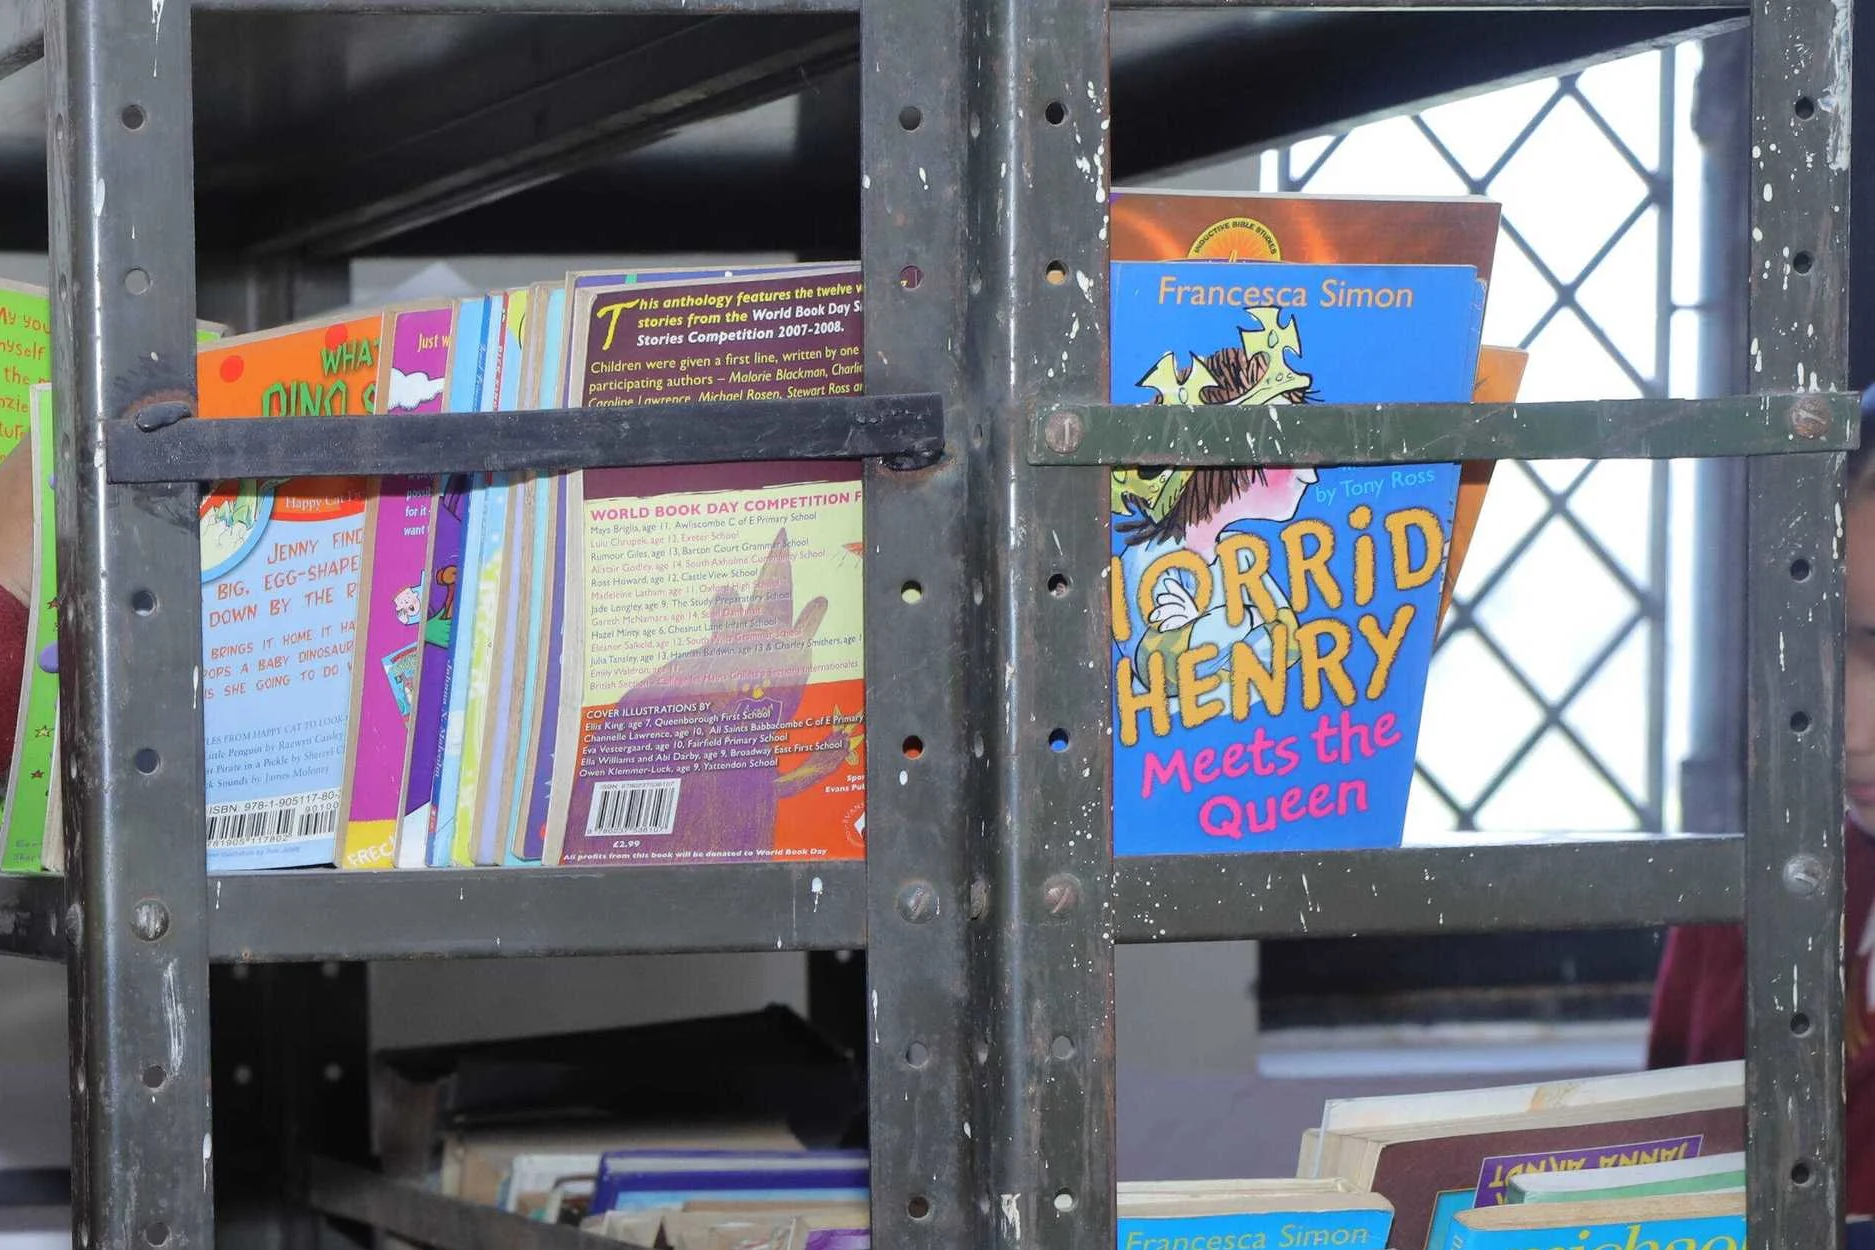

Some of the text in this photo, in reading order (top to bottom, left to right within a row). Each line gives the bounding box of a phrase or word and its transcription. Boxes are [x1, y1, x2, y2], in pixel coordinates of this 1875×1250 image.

[663, 293, 733, 309] anthology
[737, 290, 791, 306] features
[795, 286, 813, 300] the
[817, 284, 853, 297] twelve
[1159, 276, 1413, 308] Francesca Simon
[637, 302, 851, 328] stories from the World Book Day
[417, 333, 439, 353] Just
[637, 320, 845, 346] Stories Competition 2007-2008.
[591, 346, 859, 374] Children were given a first line, written by one
[4, 366, 29, 386] the
[589, 368, 828, 394] participating authors Malorie Blackman,
[787, 386, 825, 399] Stewart
[828, 382, 850, 395] Ross
[1315, 470, 1435, 506] by Tony Ross
[405, 506, 417, 518] for
[591, 492, 850, 521] WORLD BOOK DAY COMPETITION
[403, 526, 425, 536] want
[267, 540, 319, 565] JENNY
[209, 604, 258, 628] DOWN
[269, 598, 291, 616] BY
[305, 587, 334, 608] THE
[211, 642, 254, 660] BRINGS
[263, 637, 275, 650] IT
[283, 630, 313, 646] HOME
[321, 624, 332, 638] IT
[241, 664, 249, 674] A
[257, 656, 289, 672] BABY
[1117, 603, 1417, 747] HENRY
[224, 682, 246, 697] SHE
[256, 675, 291, 691] GOING
[301, 670, 315, 681] TO
[323, 664, 339, 677] DO
[587, 702, 711, 720] COVER ILLUSTRATIONS BY
[655, 710, 771, 728] Queenborough First School
[687, 734, 788, 749] Fairfield Primary School
[1140, 710, 1401, 800] Meets the
[209, 804, 237, 816] ISBN
[1199, 777, 1369, 841] Queen
[613, 840, 641, 848] £2.99
[756, 848, 783, 856] World
[785, 848, 807, 856] Book
[810, 848, 827, 856] Day
[1279, 1224, 1369, 1248] Simon
